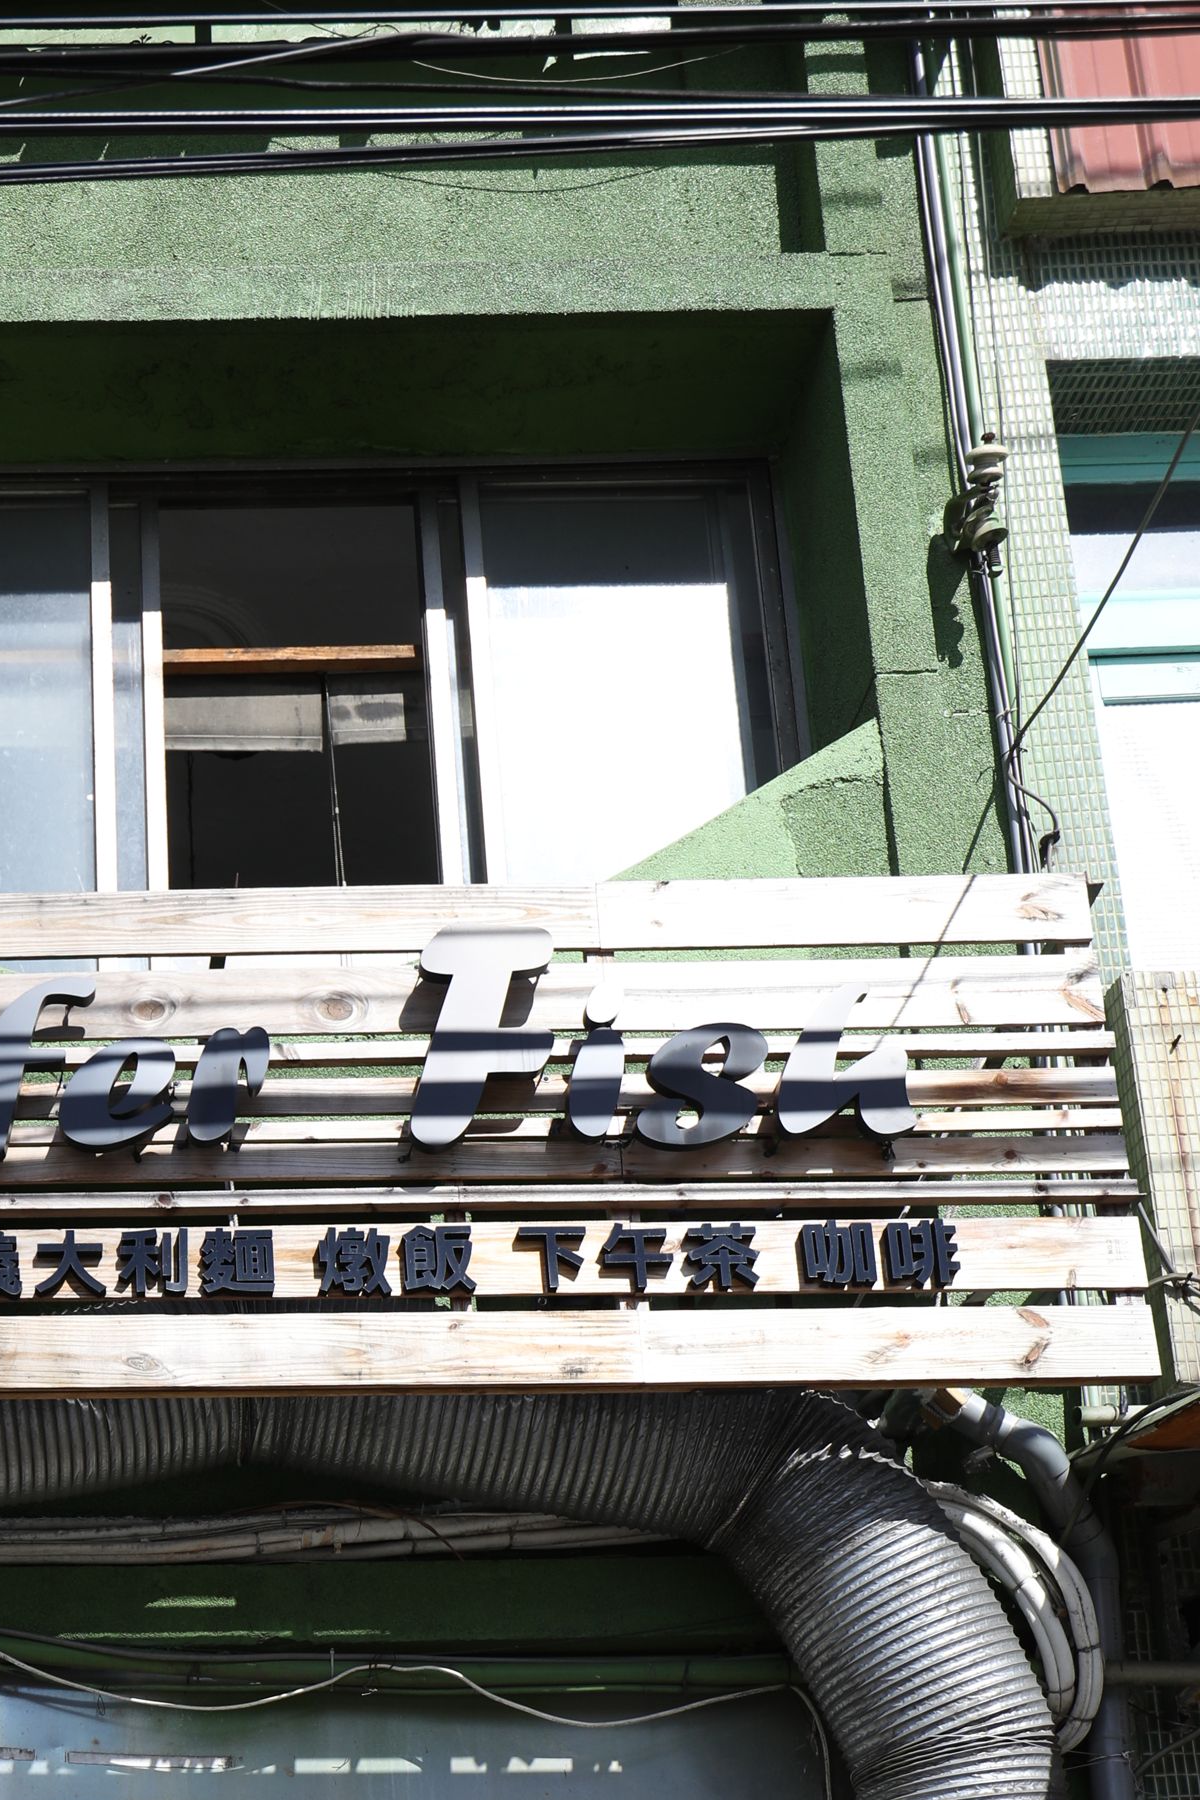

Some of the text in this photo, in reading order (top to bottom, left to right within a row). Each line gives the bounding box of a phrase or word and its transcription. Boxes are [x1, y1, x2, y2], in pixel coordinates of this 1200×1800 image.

[409, 924, 918, 1154] Fish
[314, 1225, 478, 1297] 燉飯
[514, 1222, 761, 1291] 下午茶
[794, 1219, 962, 1289] 咖啡
